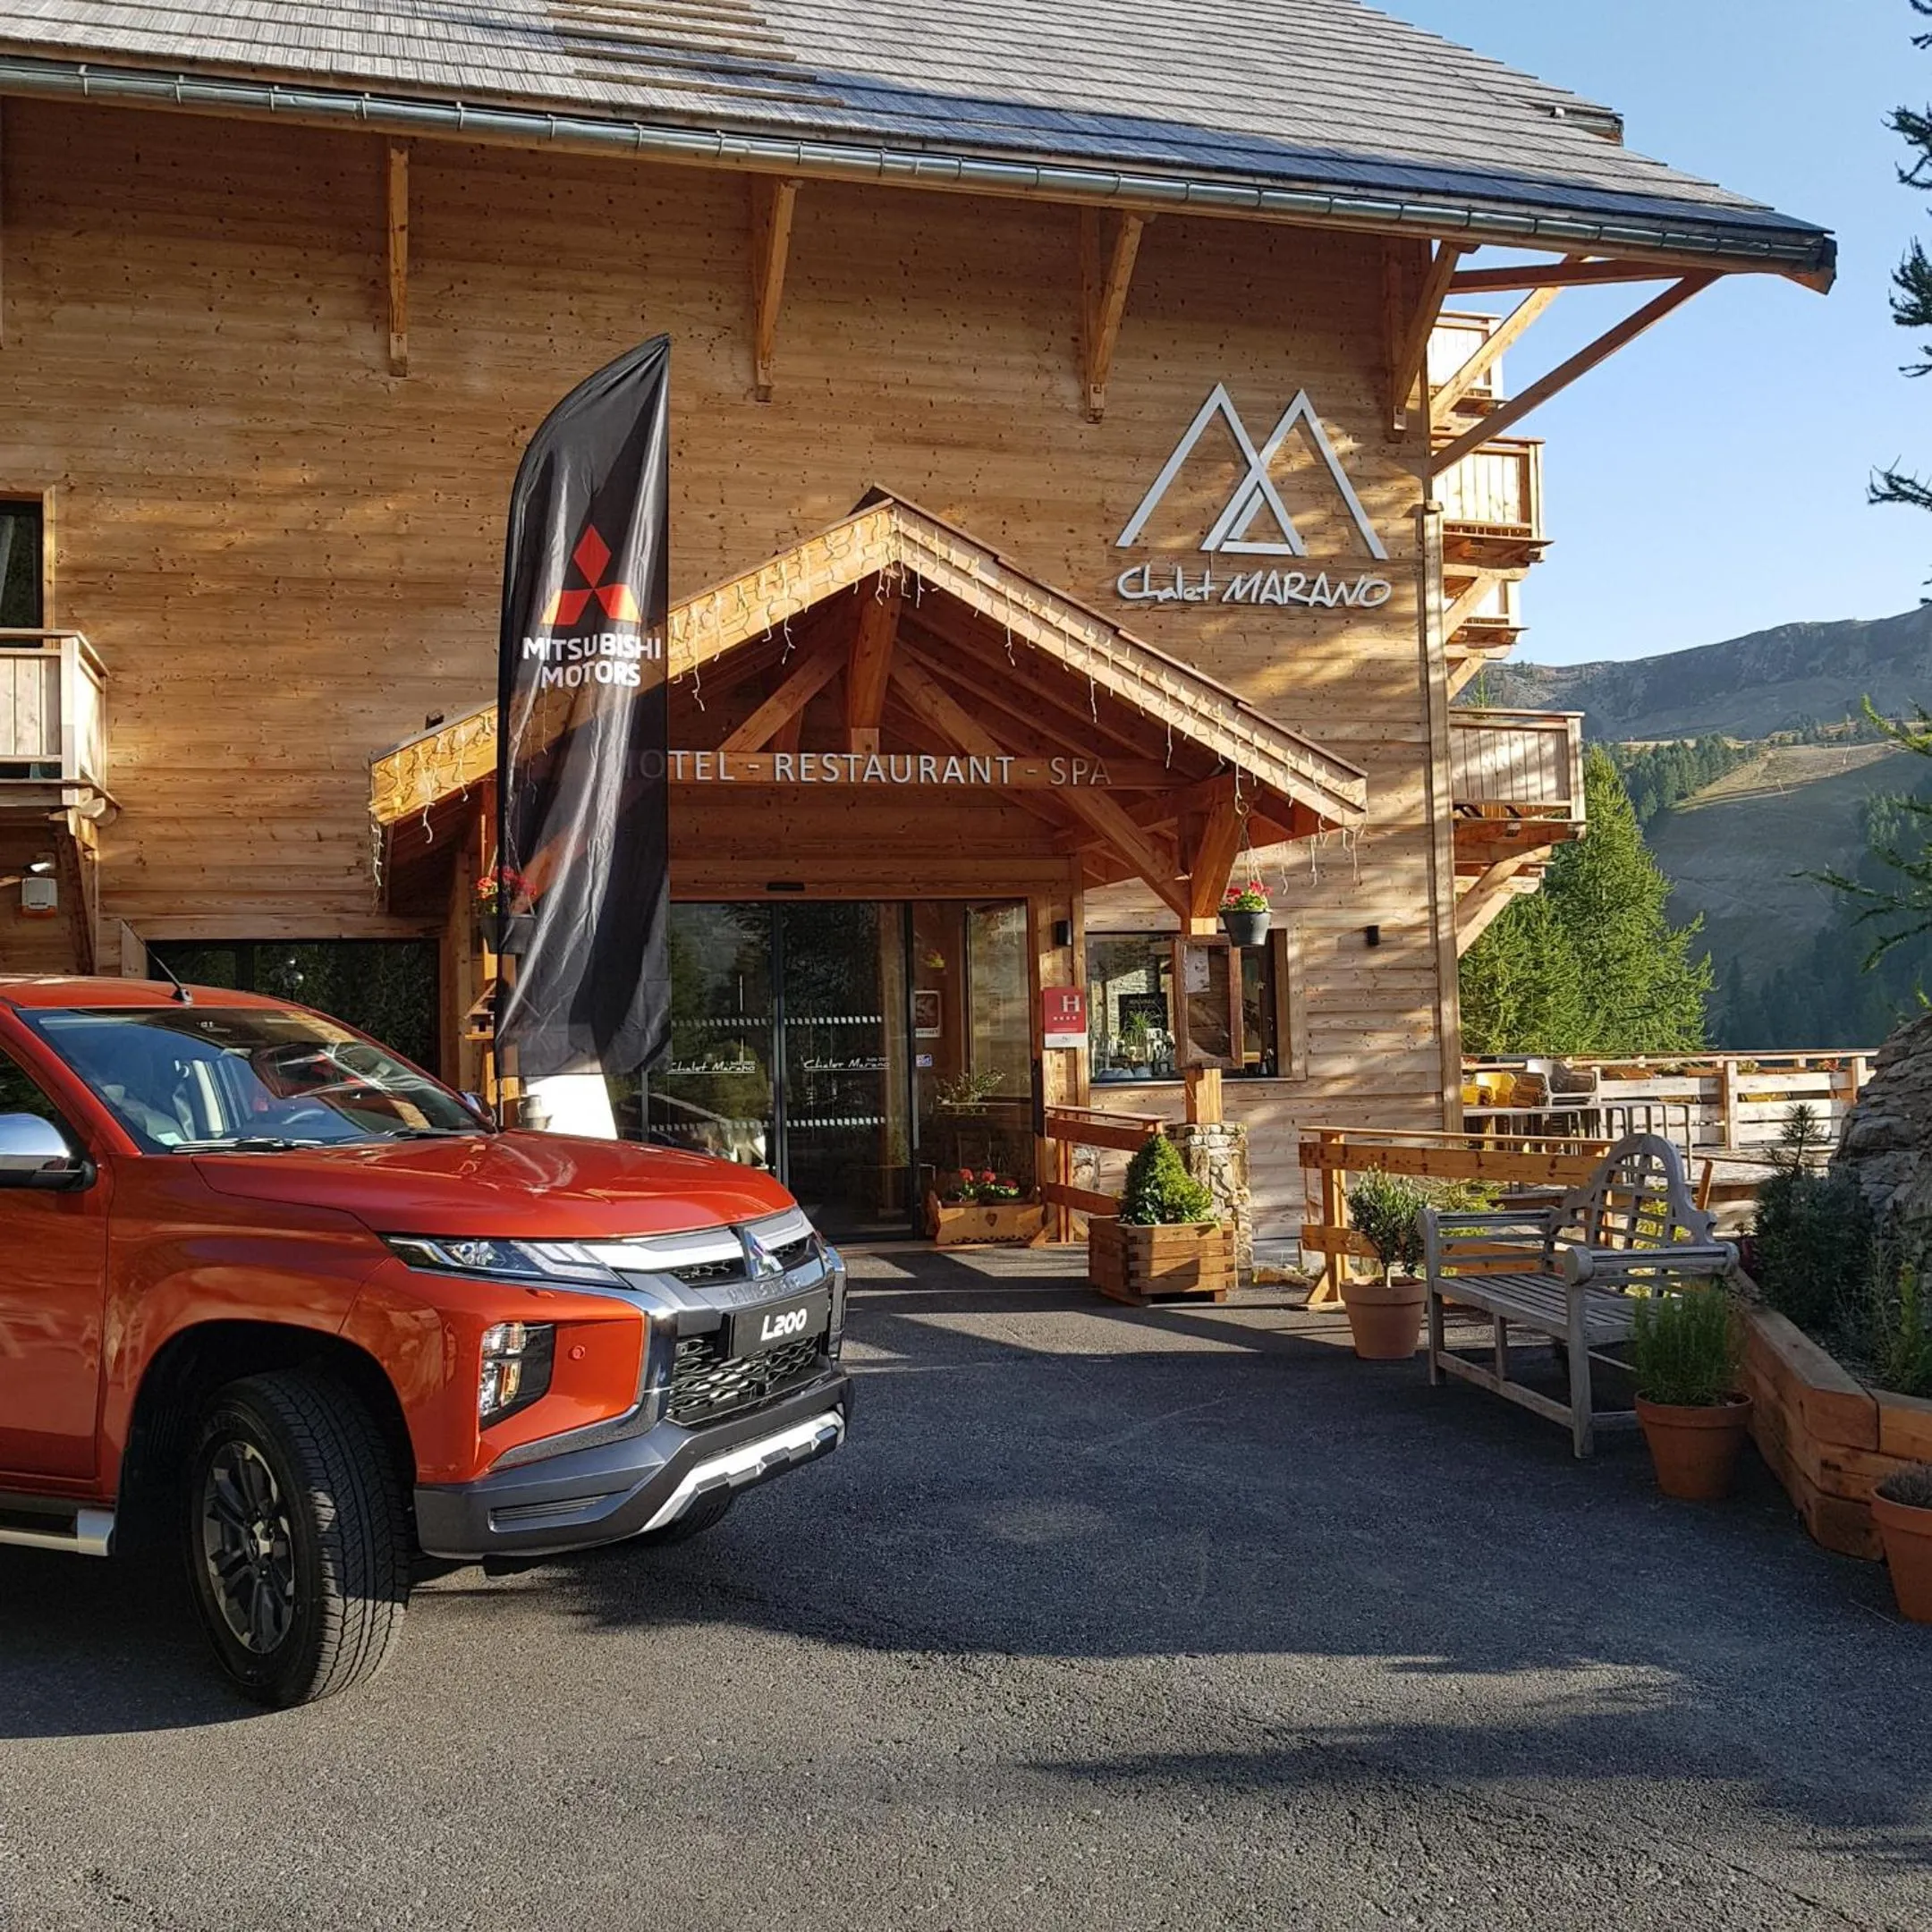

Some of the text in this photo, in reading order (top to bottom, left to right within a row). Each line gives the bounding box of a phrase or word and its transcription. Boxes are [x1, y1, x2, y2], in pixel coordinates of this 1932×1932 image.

[1117, 564, 1392, 608] Chalet MARANO
[522, 632, 661, 660] MITSUBISHI
[540, 659, 641, 689] MOTORS
[775, 752, 1015, 784] RESTAURANT
[1050, 757, 1112, 785] SPA
[1063, 995, 1080, 1013] H
[760, 1309, 808, 1341] L200
